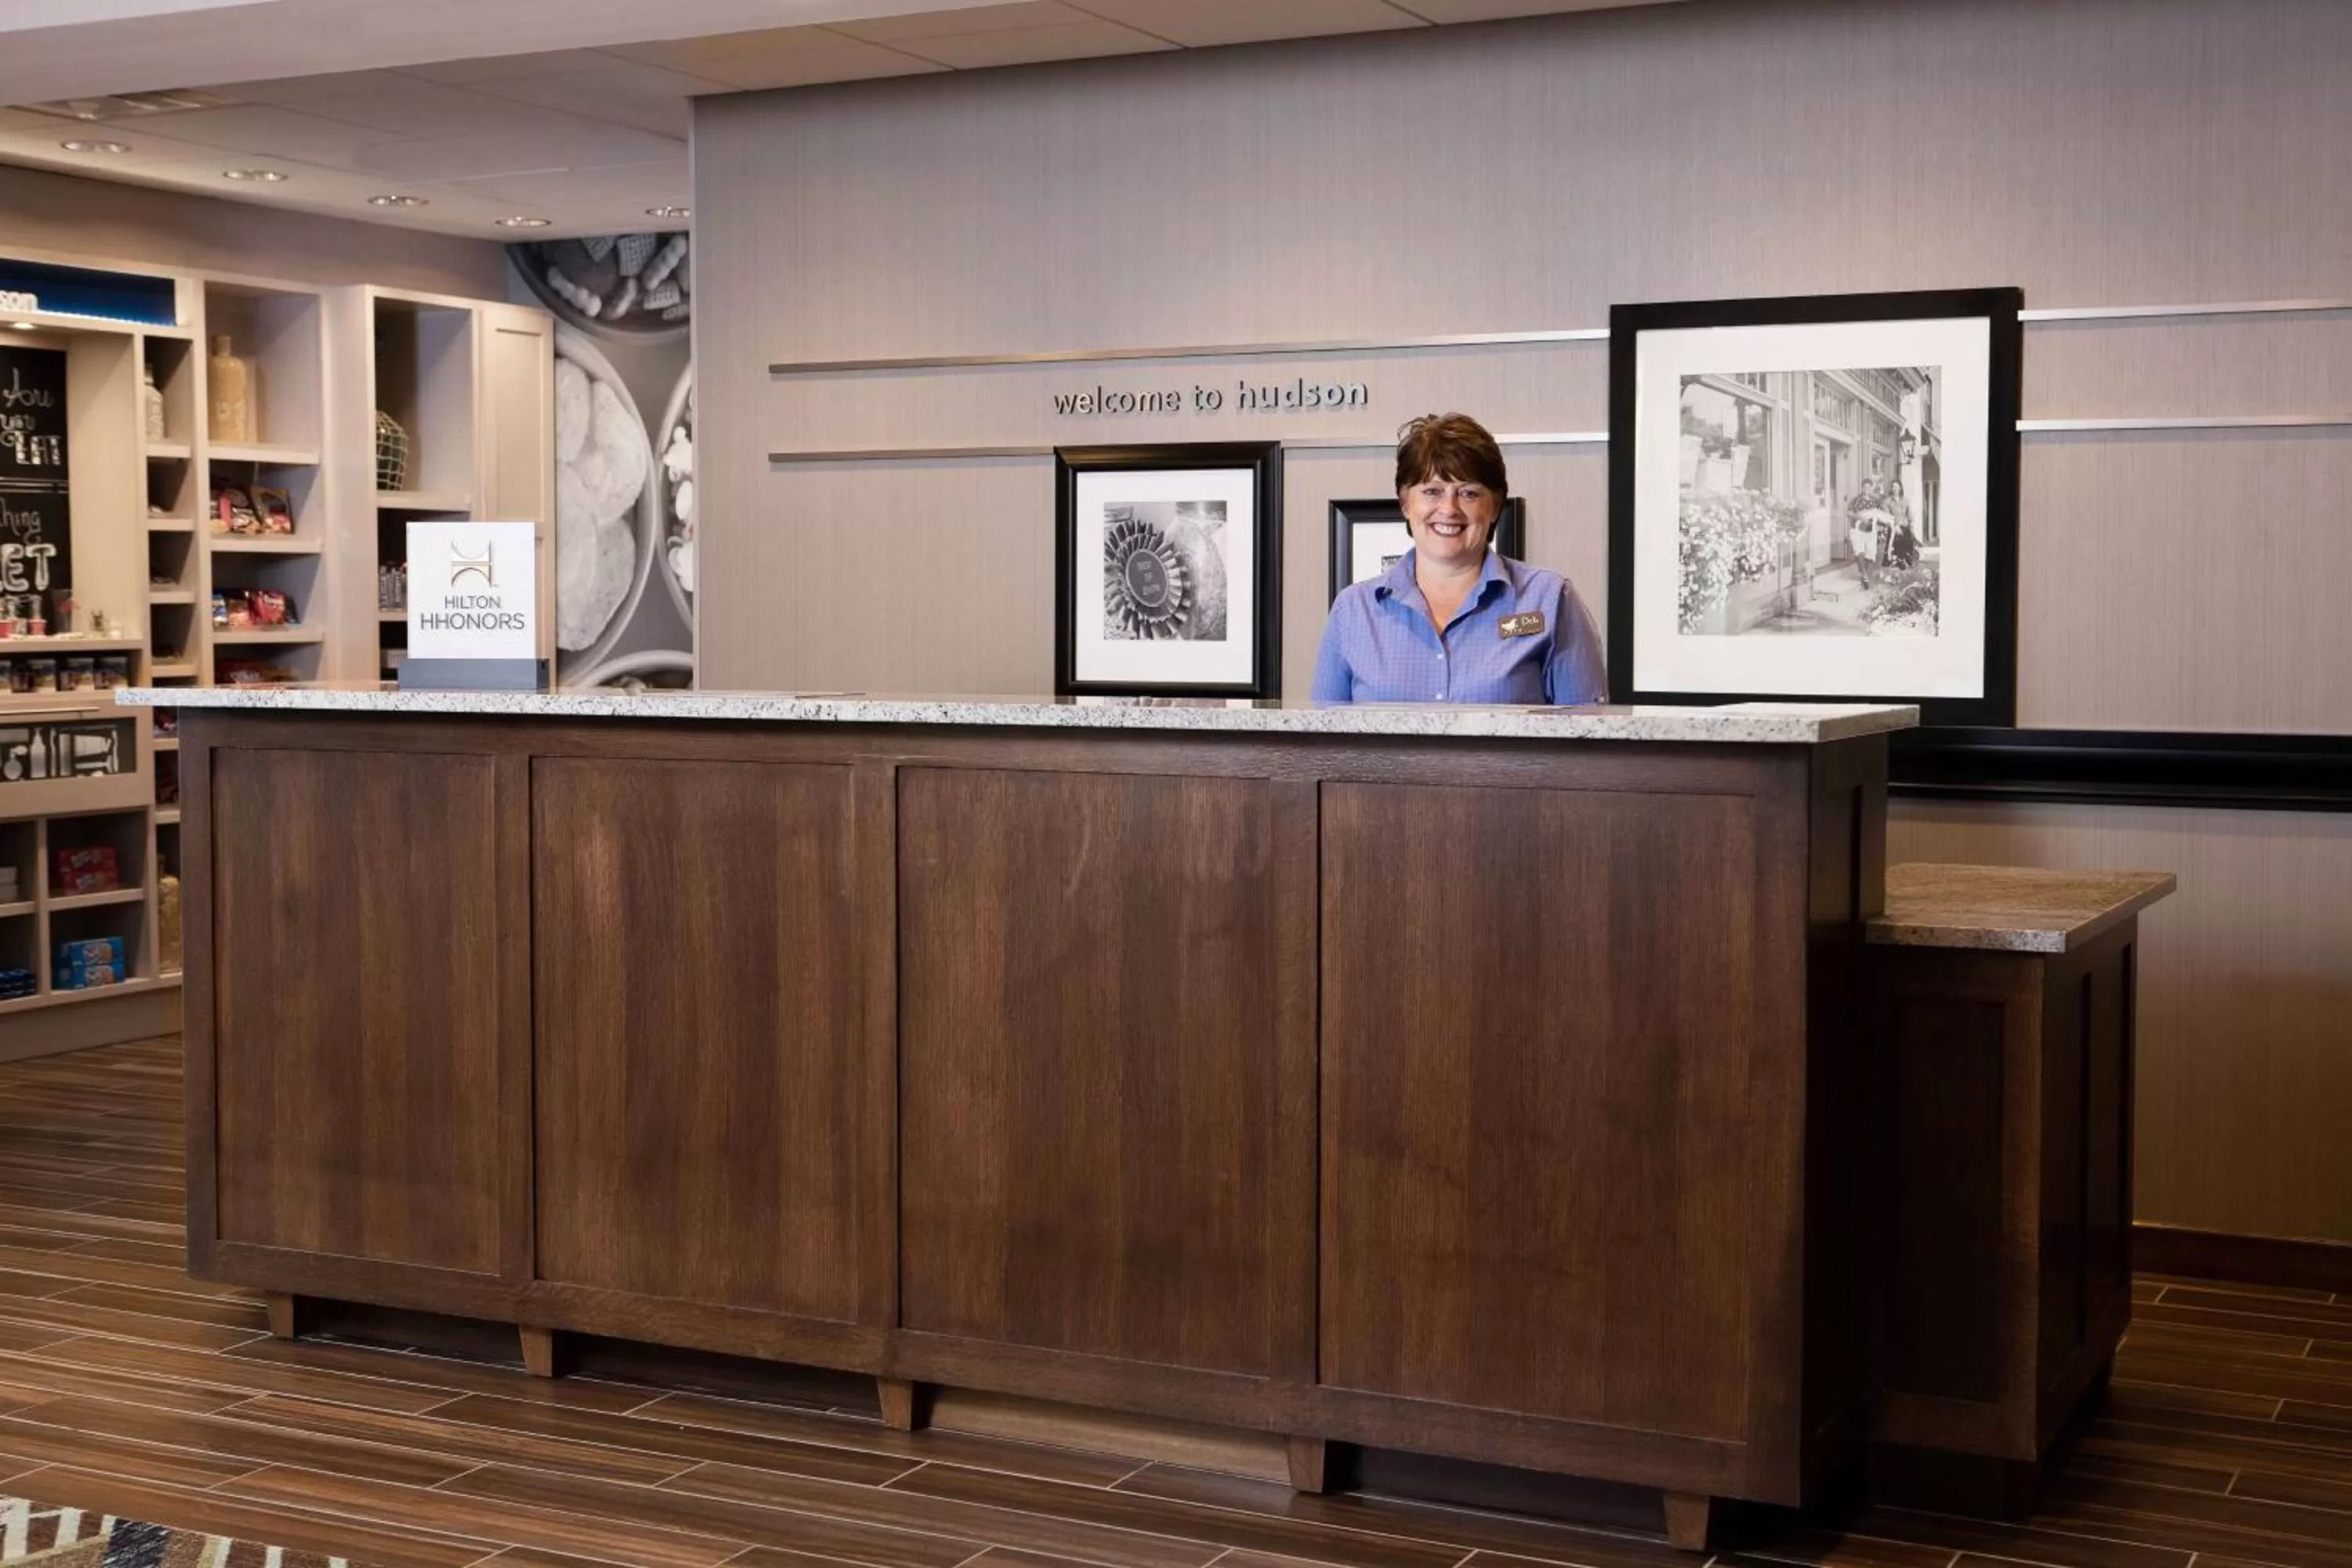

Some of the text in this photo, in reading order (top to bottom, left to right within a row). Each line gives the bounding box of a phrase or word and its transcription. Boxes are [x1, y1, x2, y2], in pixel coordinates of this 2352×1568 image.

[1054, 378, 1370, 415] welcome to hudson
[0, 500, 42, 543] hing
[0, 543, 57, 590] ET
[445, 596, 501, 608] HILTON
[420, 613, 525, 630] HHONORS
